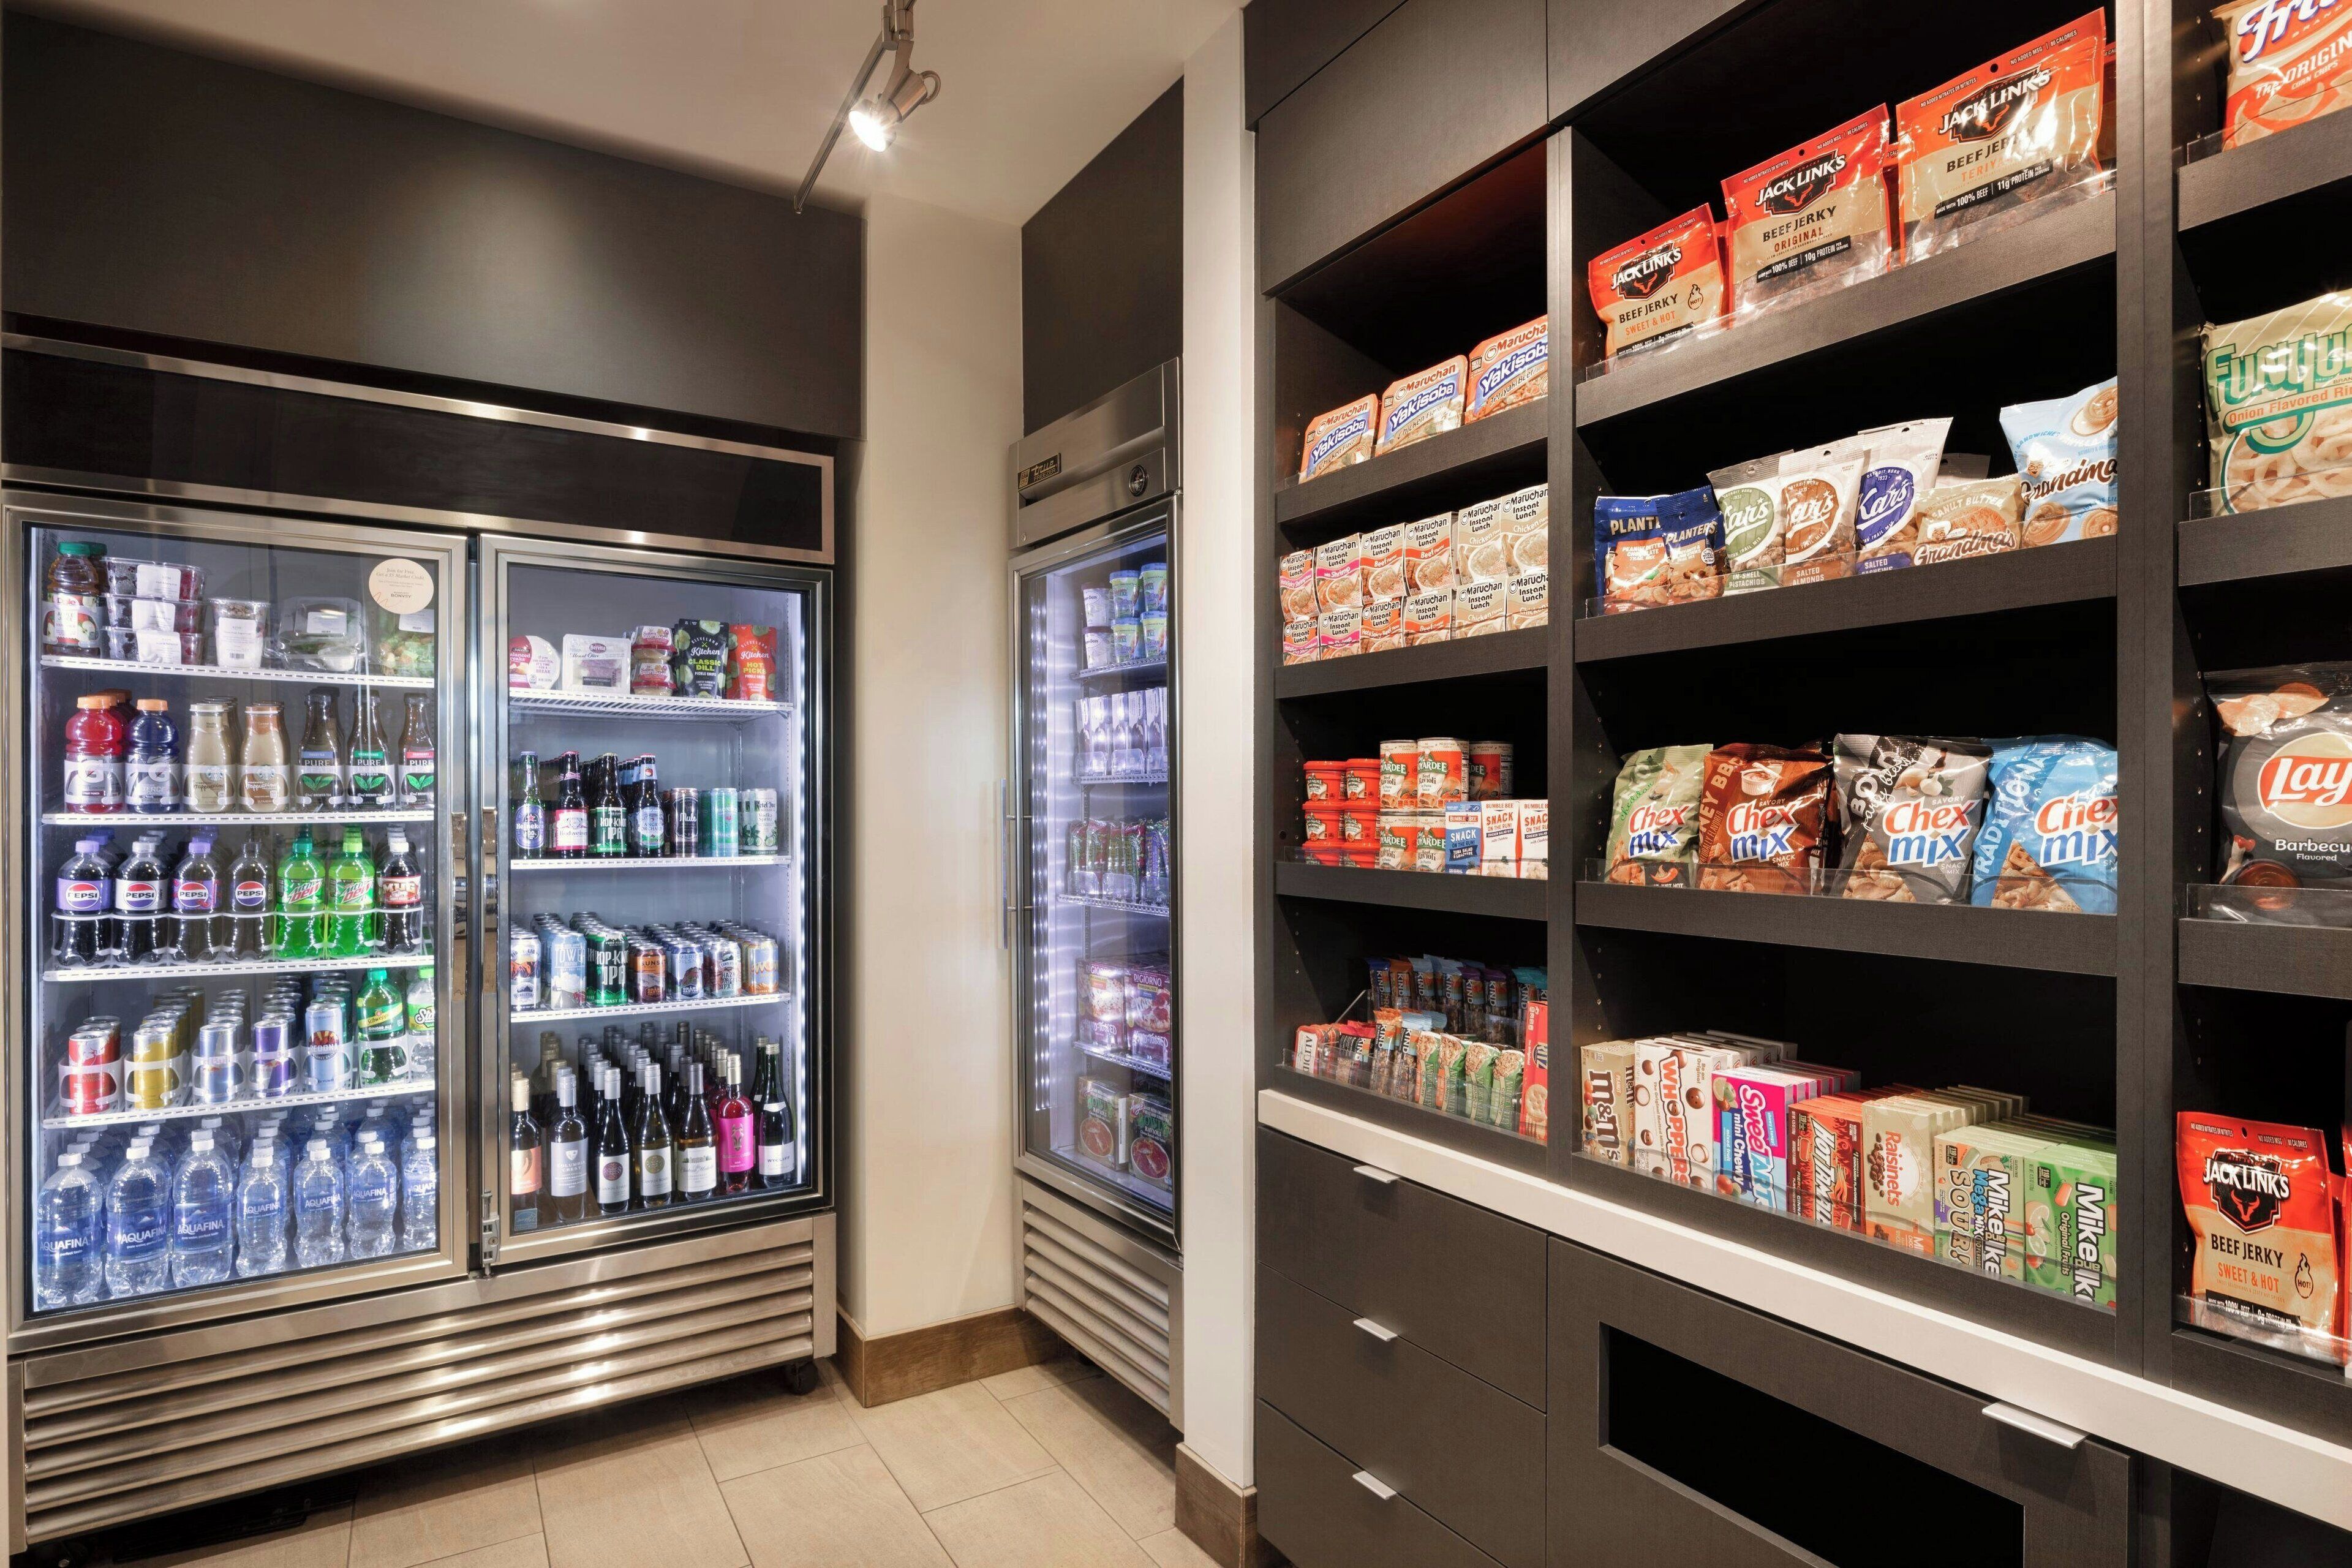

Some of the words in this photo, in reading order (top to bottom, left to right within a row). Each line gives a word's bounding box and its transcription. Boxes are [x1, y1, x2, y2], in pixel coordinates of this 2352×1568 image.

[2018, 51, 2032, 62] ADDED
[2032, 46, 2043, 56] MSG
[2056, 29, 2077, 44] CALORIES
[2291, 75, 2312, 89] CORN
[2313, 60, 2338, 78] CHIPS
[1939, 99, 1988, 135] JACK
[1990, 68, 2051, 108] LINK'S
[1947, 149, 1983, 173] BEEF
[1755, 178, 1796, 206] JACK
[1796, 154, 1846, 186] LINK'S
[1947, 202, 1956, 211] WITH
[1956, 192, 1975, 207] 100%
[1977, 187, 1989, 199] BEEF
[1997, 178, 2010, 191] 11g
[2011, 169, 2034, 186] PROTEIN
[1763, 222, 1792, 243] BEEF
[1793, 206, 1836, 232] JERKY
[1774, 227, 1824, 252] ORIGINAL
[1611, 260, 1642, 290] JACK
[1643, 248, 1683, 276] LINK'S
[1771, 262, 1787, 274] 100%
[1789, 257, 1798, 268] BEEF
[1804, 252, 1815, 262] 10g
[1817, 244, 1835, 258] PROTEIN
[1619, 306, 1643, 323] BEEF
[1645, 293, 1678, 315] JERKY
[1625, 320, 1649, 336] SWEET
[1660, 311, 1676, 323] HOT
[1406, 364, 1456, 393] Maruchan
[1326, 401, 1368, 427] Maruchan
[1390, 382, 1455, 431] Yakisoba
[2229, 407, 2264, 424] Onion
[2269, 389, 2329, 413] Flavored
[1313, 420, 1366, 463] Yakisoba
[1513, 502, 1539, 513] Instant
[1966, 494, 2003, 507] BUTTER
[1513, 520, 1539, 532] Chicken
[1515, 510, 1537, 520] Lunch
[1369, 530, 1400, 543] Maruchan
[1371, 540, 1392, 550] Instant
[1665, 521, 1718, 545] PLANTERS
[1872, 530, 1883, 540] TRAIL
[1287, 552, 1311, 564] Maruchan
[1324, 541, 1356, 554] Maruchan
[1326, 552, 1348, 561] Instant
[1913, 528, 2016, 566] Grandma's
[1329, 559, 1346, 567] Lunch
[1374, 559, 1386, 568] Beef
[1733, 570, 1760, 579] IN-SHELL
[1796, 567, 1820, 578] SALTED
[1864, 559, 1888, 569] SALTED
[1729, 578, 1765, 588] PISTACHIOS
[1793, 574, 1824, 586] ALMONDS
[691, 647, 720, 655] Kitchen
[741, 650, 769, 659] Kitchen
[1758, 797, 1785, 807] SAVORY
[1932, 795, 1965, 806] SAVORY
[680, 813, 696, 822] Mule
[1486, 812, 1513, 826] SNACK
[1629, 804, 1691, 832] Chex
[1728, 798, 1799, 834] Chex
[1884, 800, 1981, 834] Chex
[1451, 829, 1476, 842] SNACK
[1629, 828, 1681, 856] mix
[1732, 827, 1794, 862] mix
[1890, 829, 1971, 865] mix
[1771, 854, 1795, 864] SNACK
[1940, 862, 1966, 870] SNACK
[2296, 853, 2337, 862] Flavored
[1378, 1024, 1387, 1049] KIND
[1403, 1028, 1412, 1054] KIND
[1734, 1139, 1744, 1186] Chewy
[1885, 1131, 1902, 1207] Raisinets
[2203, 1158, 2241, 1189] JACK
[2242, 1164, 2290, 1198] LINK'S
[305, 1196, 341, 1208] AQUAFINA
[1970, 1169, 1989, 1215] Mega
[1987, 1169, 2010, 1237] Mike
[178, 1219, 225, 1235] AQUAFINA
[1950, 1169, 1971, 1265] SOUR!
[2076, 1182, 2105, 1262] Mike
[121, 1224, 167, 1244] AQUAFINA
[2060, 1212, 2072, 1248] Original
[40, 1237, 90, 1253] AQUAFINA
[2211, 1233, 2241, 1257] BEEF
[2242, 1242, 2283, 1268] JERKY
[2060, 1248, 2071, 1276] Fruits
[2218, 1262, 2247, 1285] SWEET
[2251, 1270, 2258, 1287] &
[2260, 1273, 2279, 1294] HOT
[2297, 1280, 2312, 1289] HOT!
